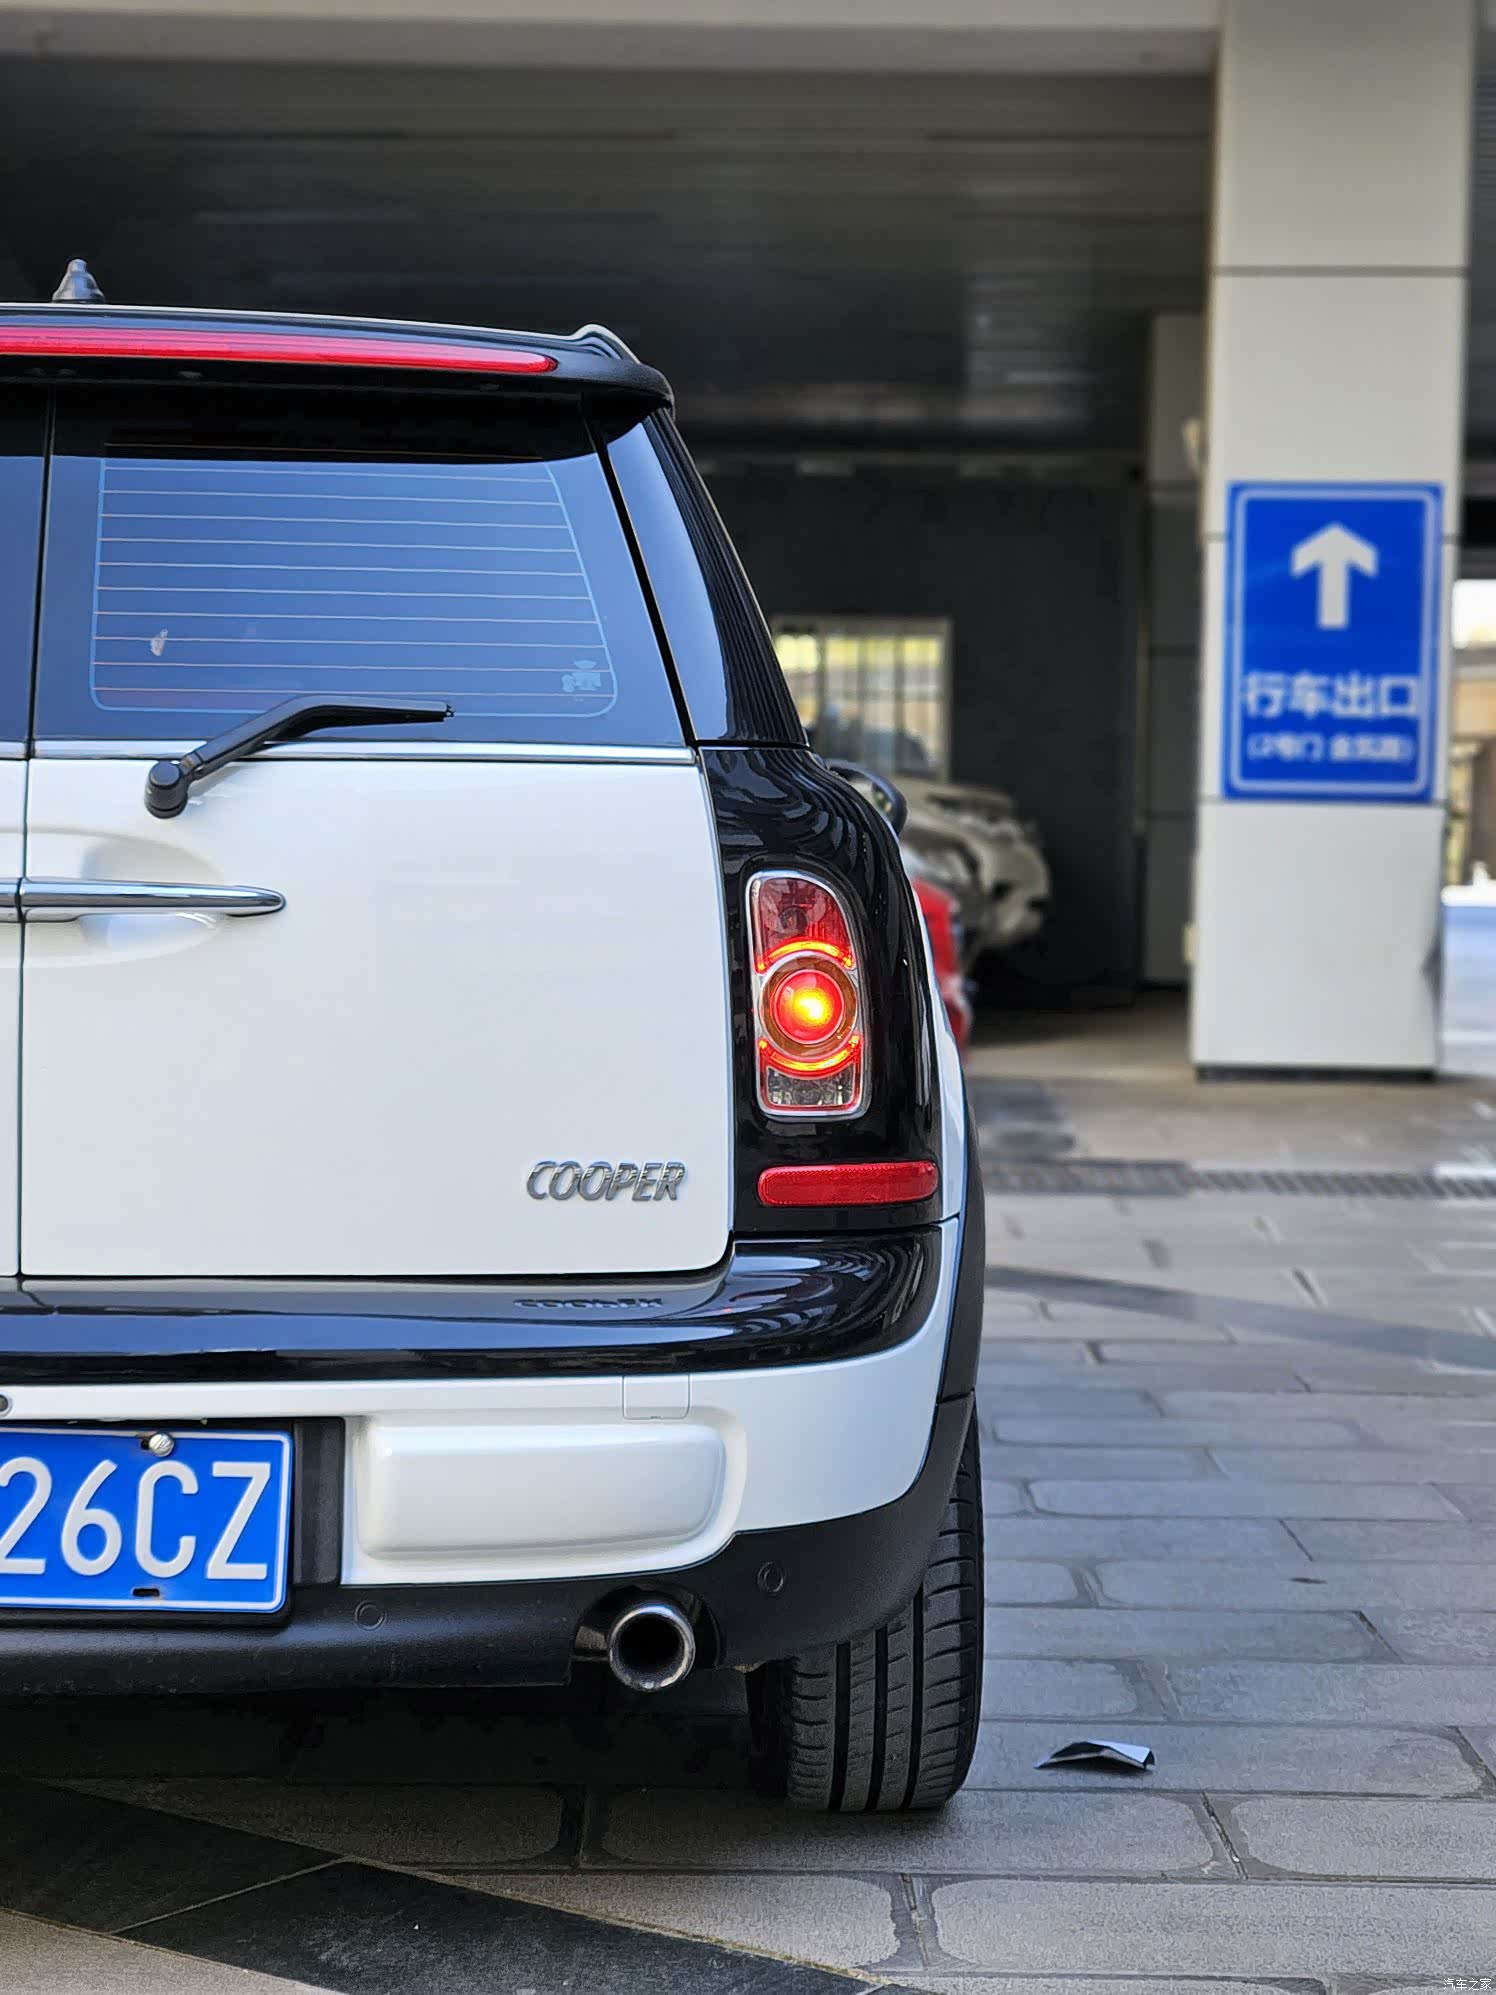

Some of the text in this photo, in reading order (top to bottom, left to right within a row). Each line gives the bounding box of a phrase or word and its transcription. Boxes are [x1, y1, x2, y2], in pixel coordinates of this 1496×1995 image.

[1245, 670, 1419, 718] 行车出口
[526, 1160, 685, 1201] COOPER
[0, 1456, 271, 1580] 26CZ
